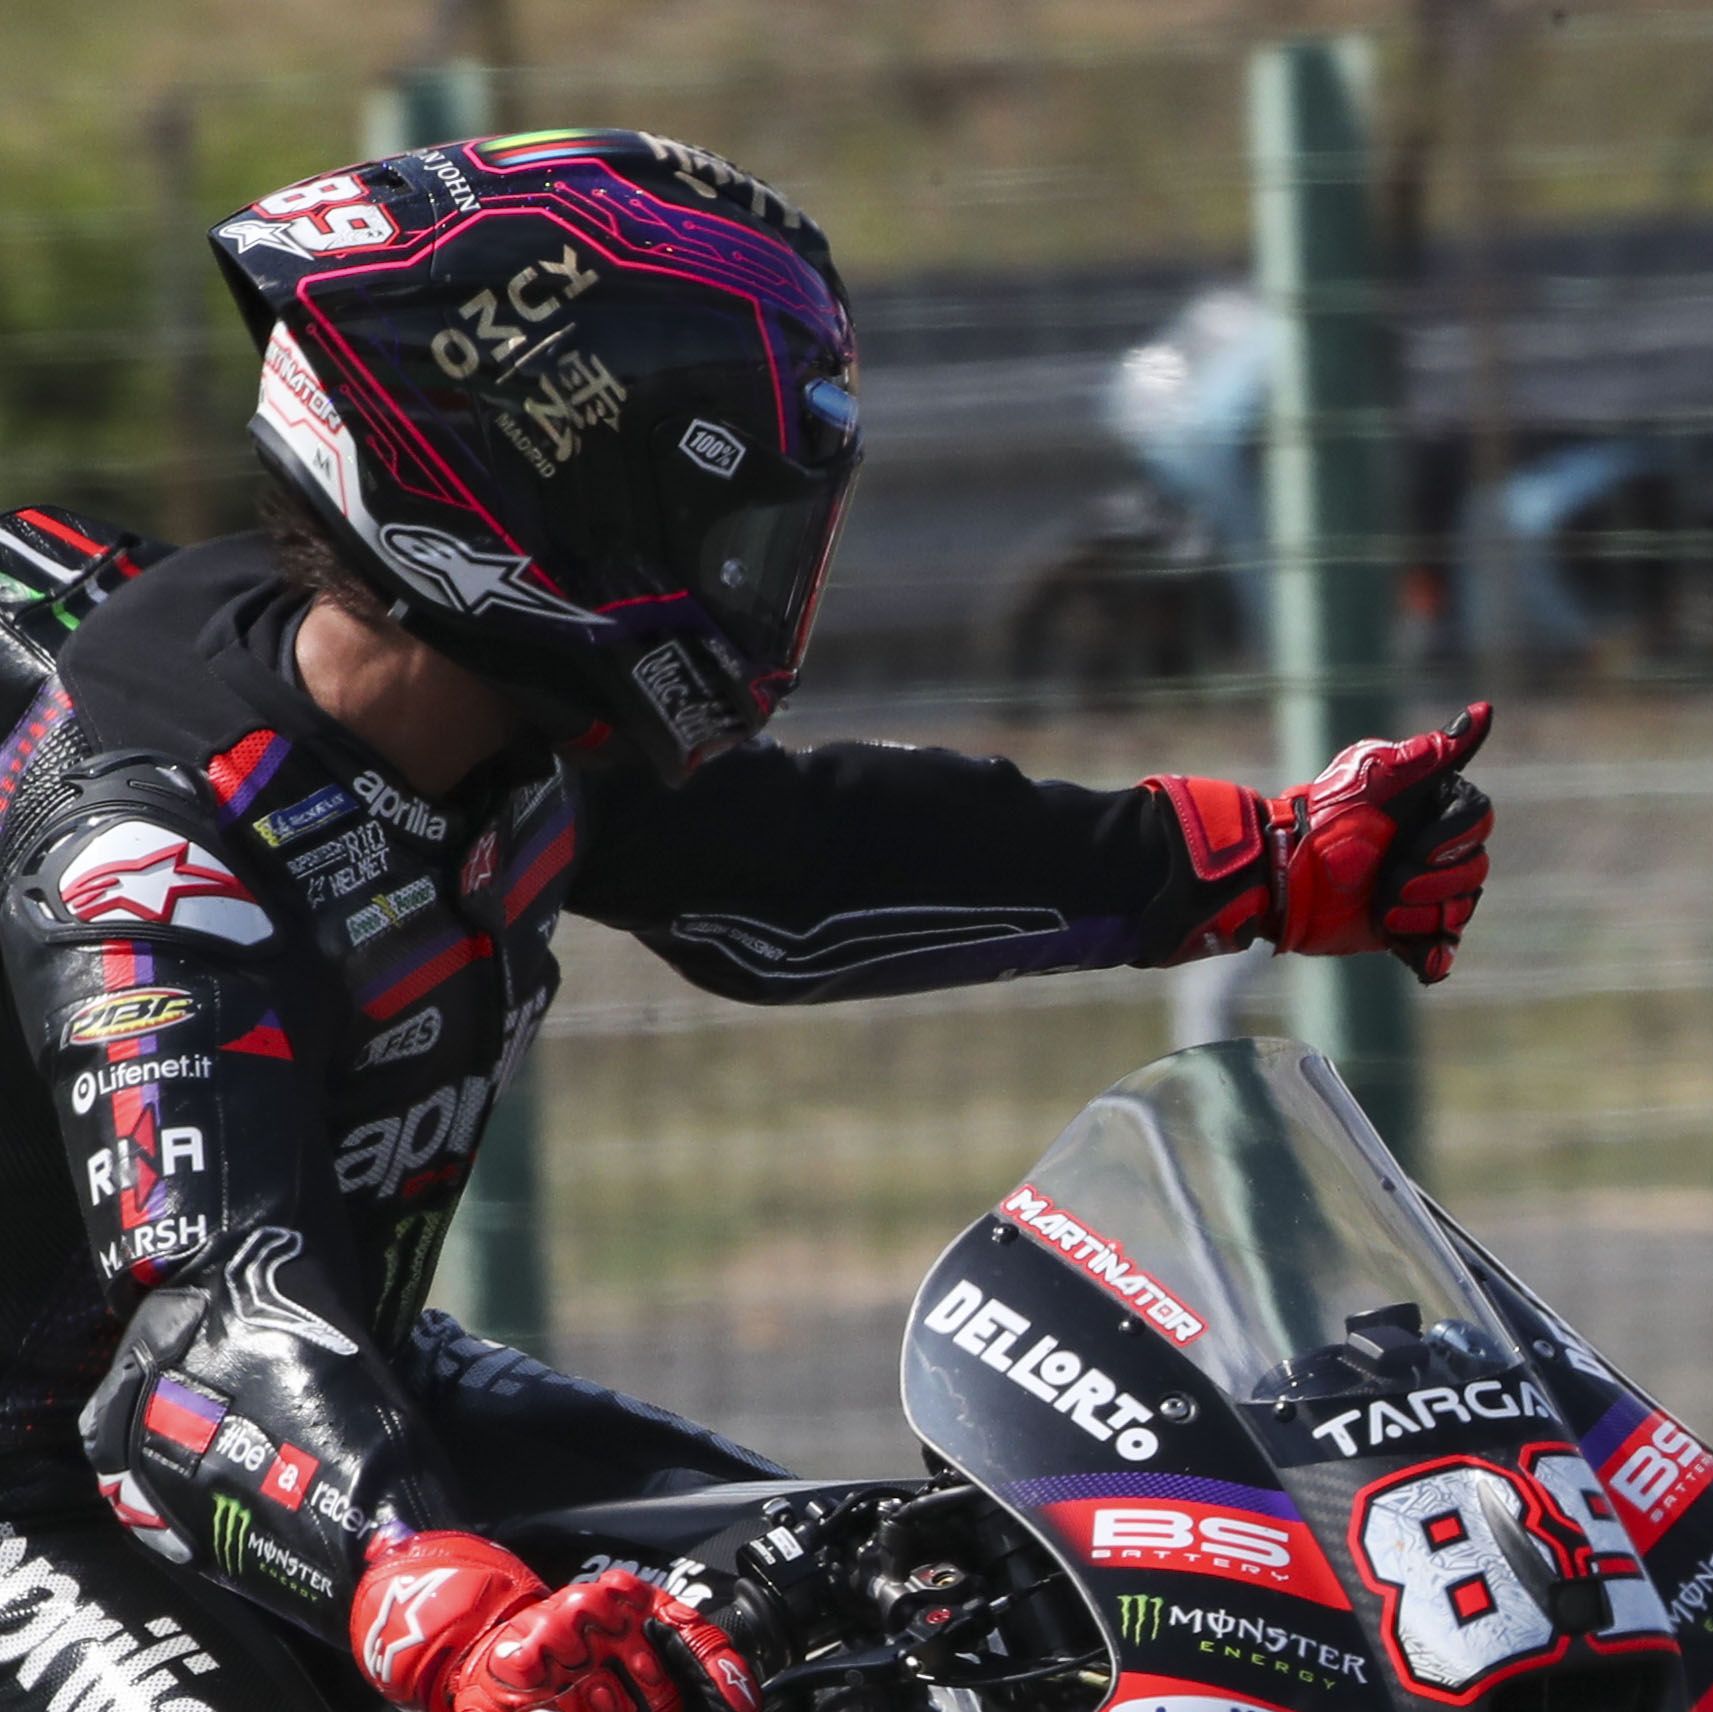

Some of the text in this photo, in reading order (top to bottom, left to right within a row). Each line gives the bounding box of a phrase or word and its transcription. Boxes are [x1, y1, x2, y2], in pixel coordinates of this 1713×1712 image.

[254, 172, 396, 252] 89
[495, 411, 558, 480] MADRID
[689, 425, 738, 469] 100%
[353, 769, 449, 844] aprilia
[98, 1053, 212, 1096] Lifenet.it
[101, 1214, 207, 1279] MARSH
[1006, 1188, 1203, 1343] MARTINATOR
[923, 1279, 1159, 1462] DELLORTO
[214, 1415, 267, 1474] #be
[1312, 1379, 1558, 1458] TARGA
[1609, 1416, 1705, 1514] BS
[248, 1537, 334, 1596] MONSTER
[1091, 1548, 1290, 1582] BATTERY
[1092, 1509, 1290, 1567] BS
[1168, 1603, 1367, 1684] MONSTER
[1199, 1640, 1336, 1691] ENERGY
